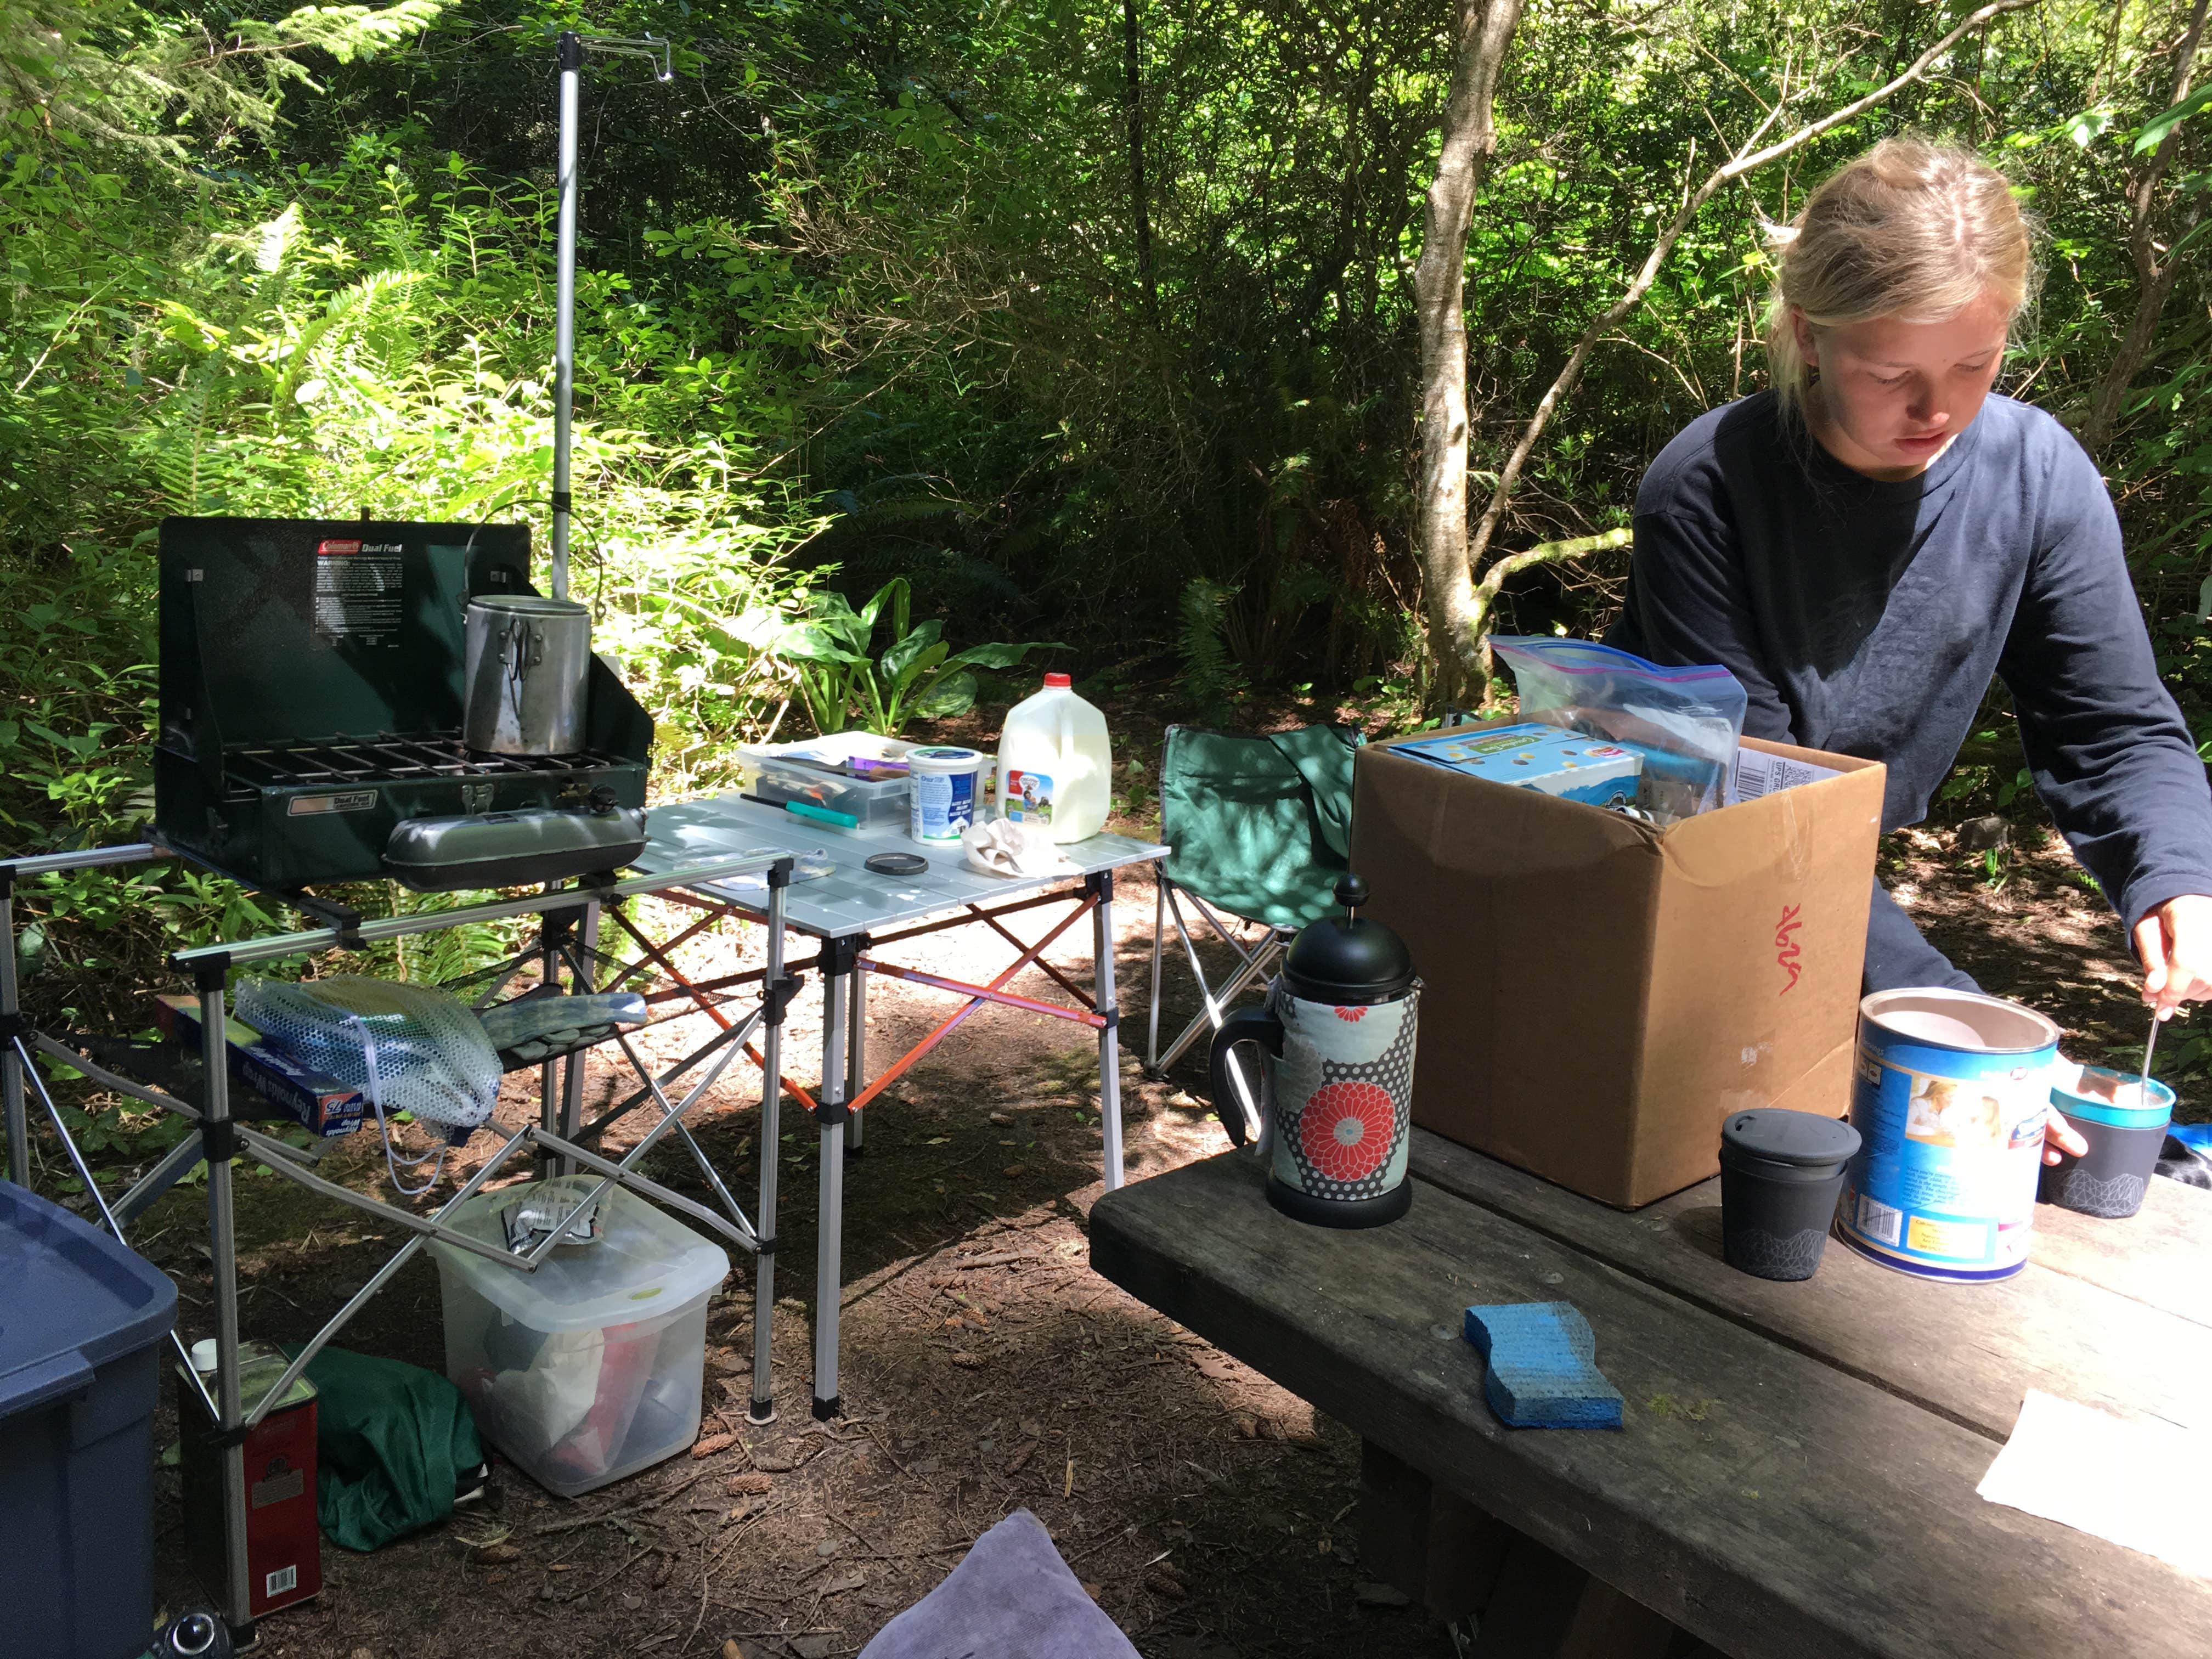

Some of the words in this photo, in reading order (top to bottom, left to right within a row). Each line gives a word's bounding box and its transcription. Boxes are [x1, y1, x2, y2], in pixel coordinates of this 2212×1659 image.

[322, 540, 352, 550] Coleman
[324, 1098, 343, 1115] 75
[341, 1119, 360, 1127] Wrap
[325, 1125, 359, 1137] Reynolds
